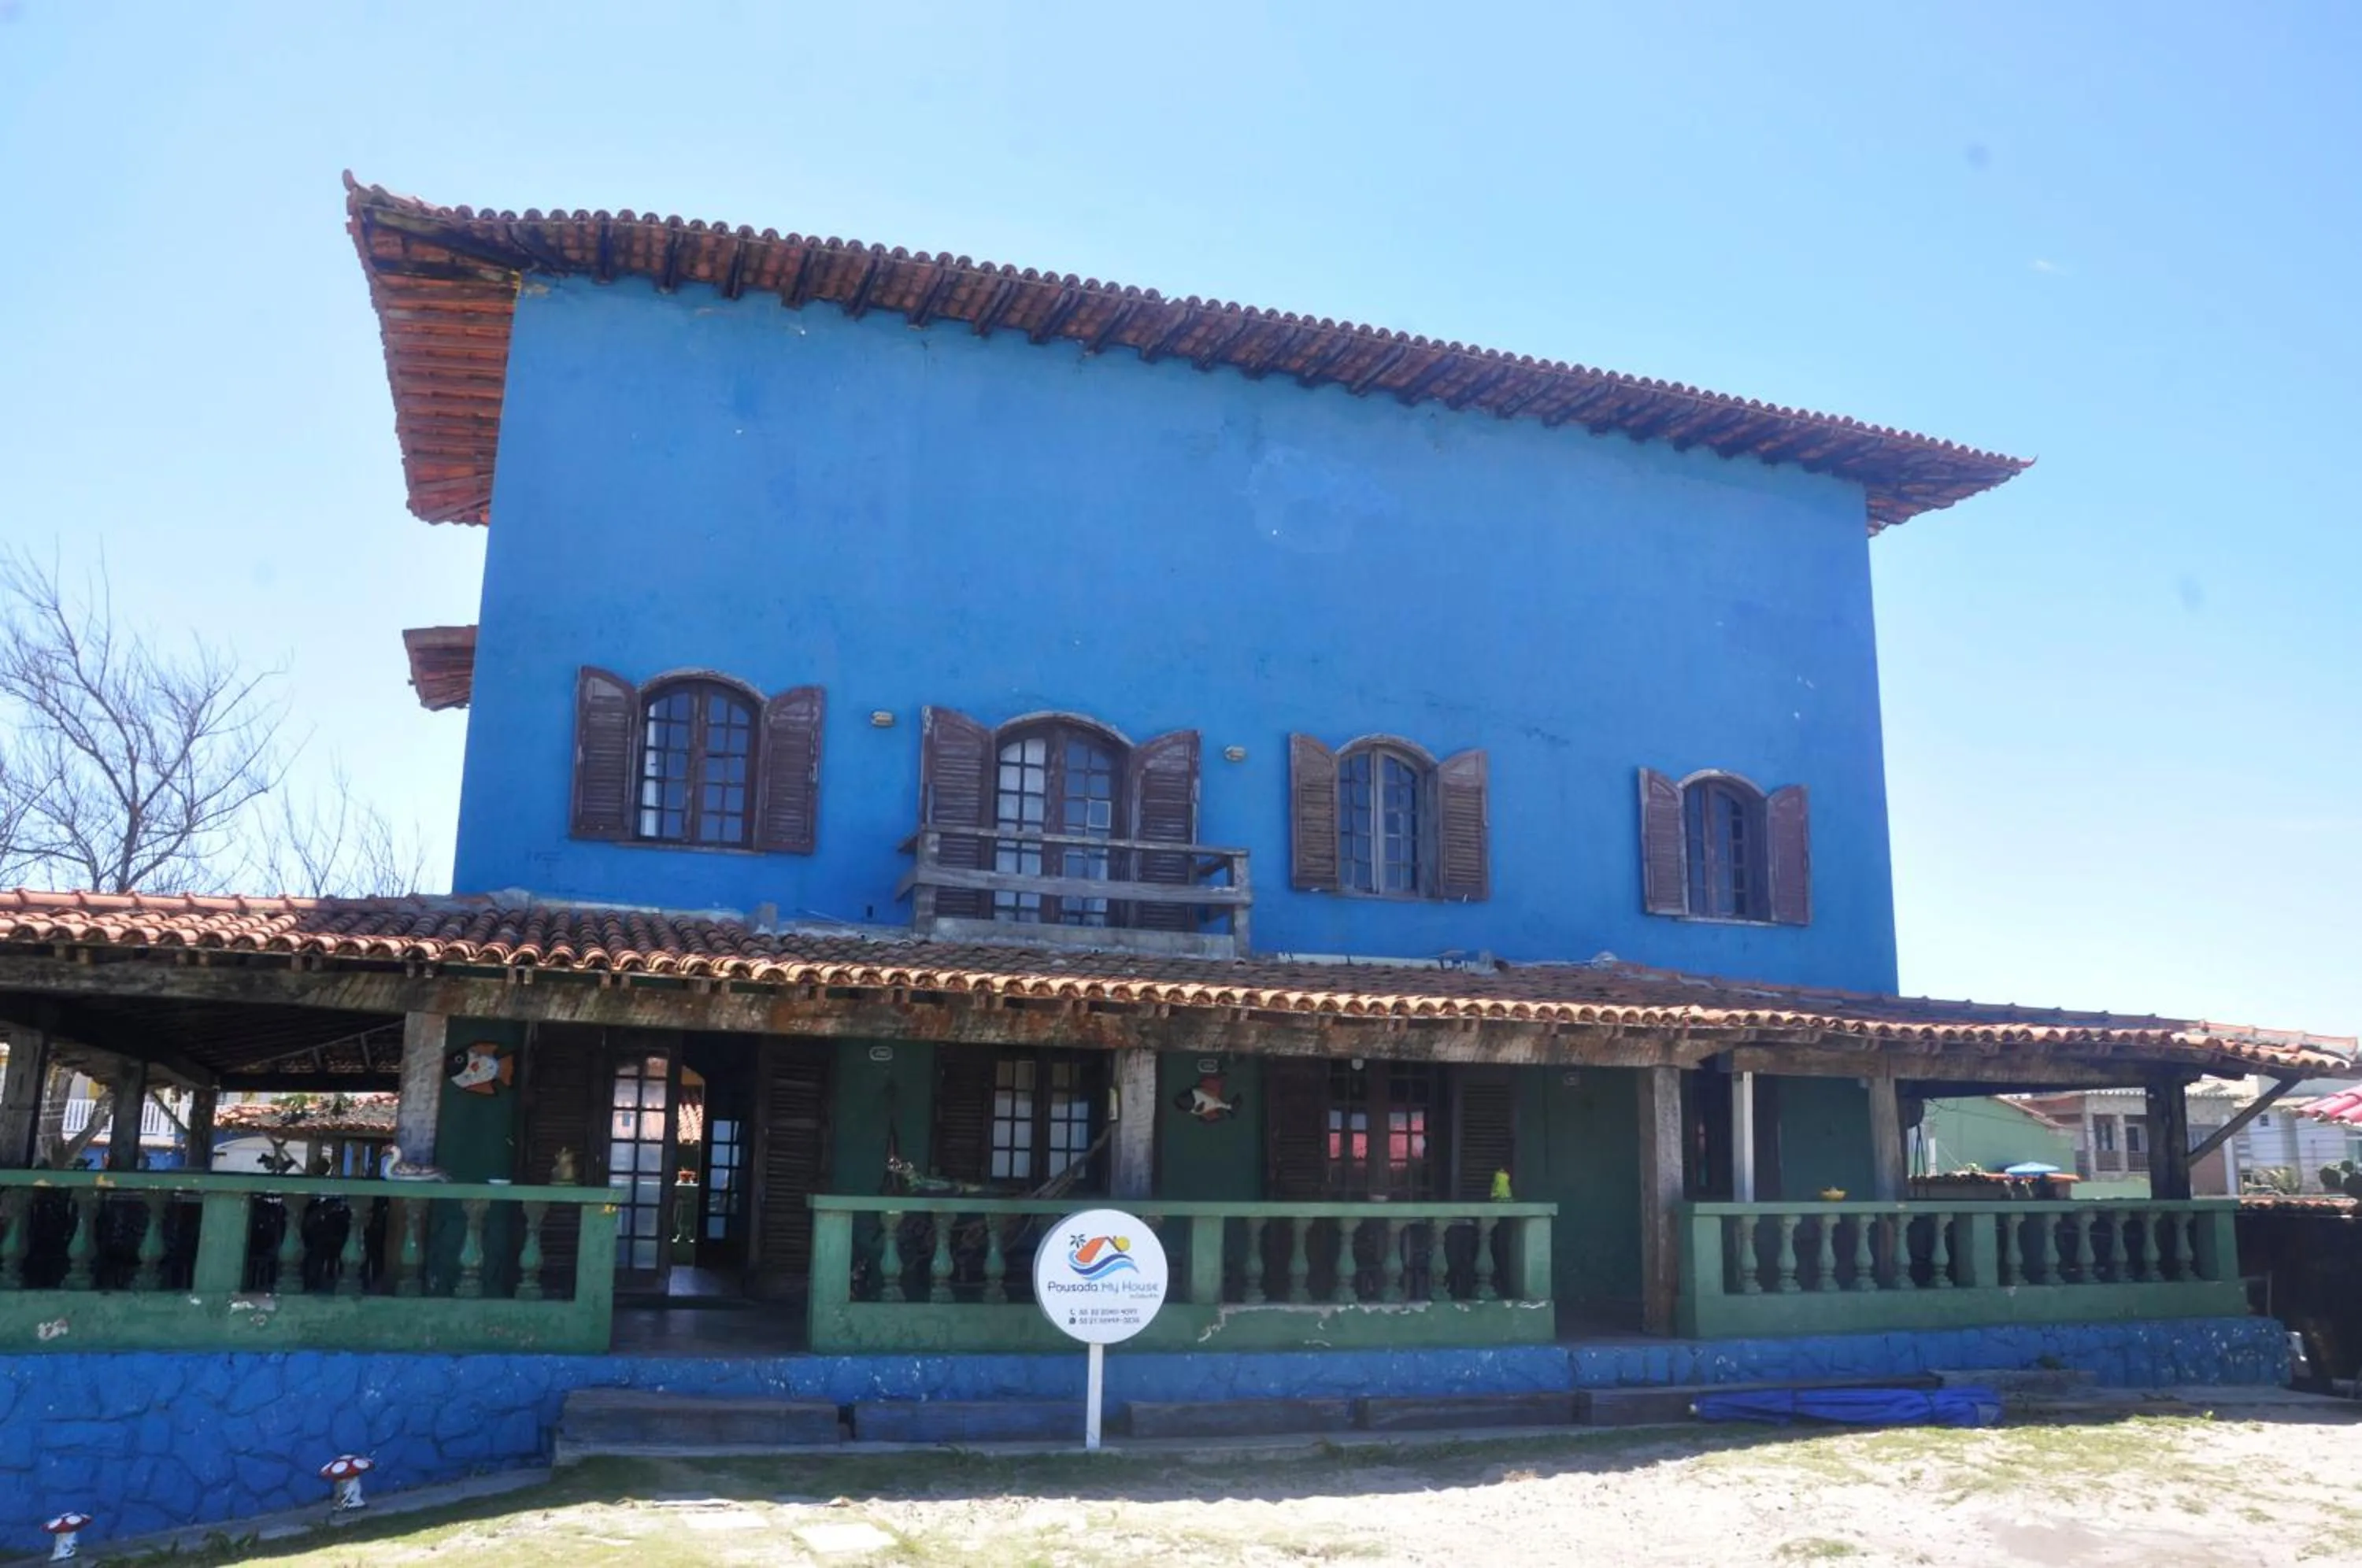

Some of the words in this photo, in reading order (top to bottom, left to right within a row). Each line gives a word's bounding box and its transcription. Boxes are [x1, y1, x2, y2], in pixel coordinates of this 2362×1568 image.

[1047, 1281, 1098, 1292] Pousada
[1101, 1281, 1119, 1294] My
[1121, 1281, 1159, 1292] House
